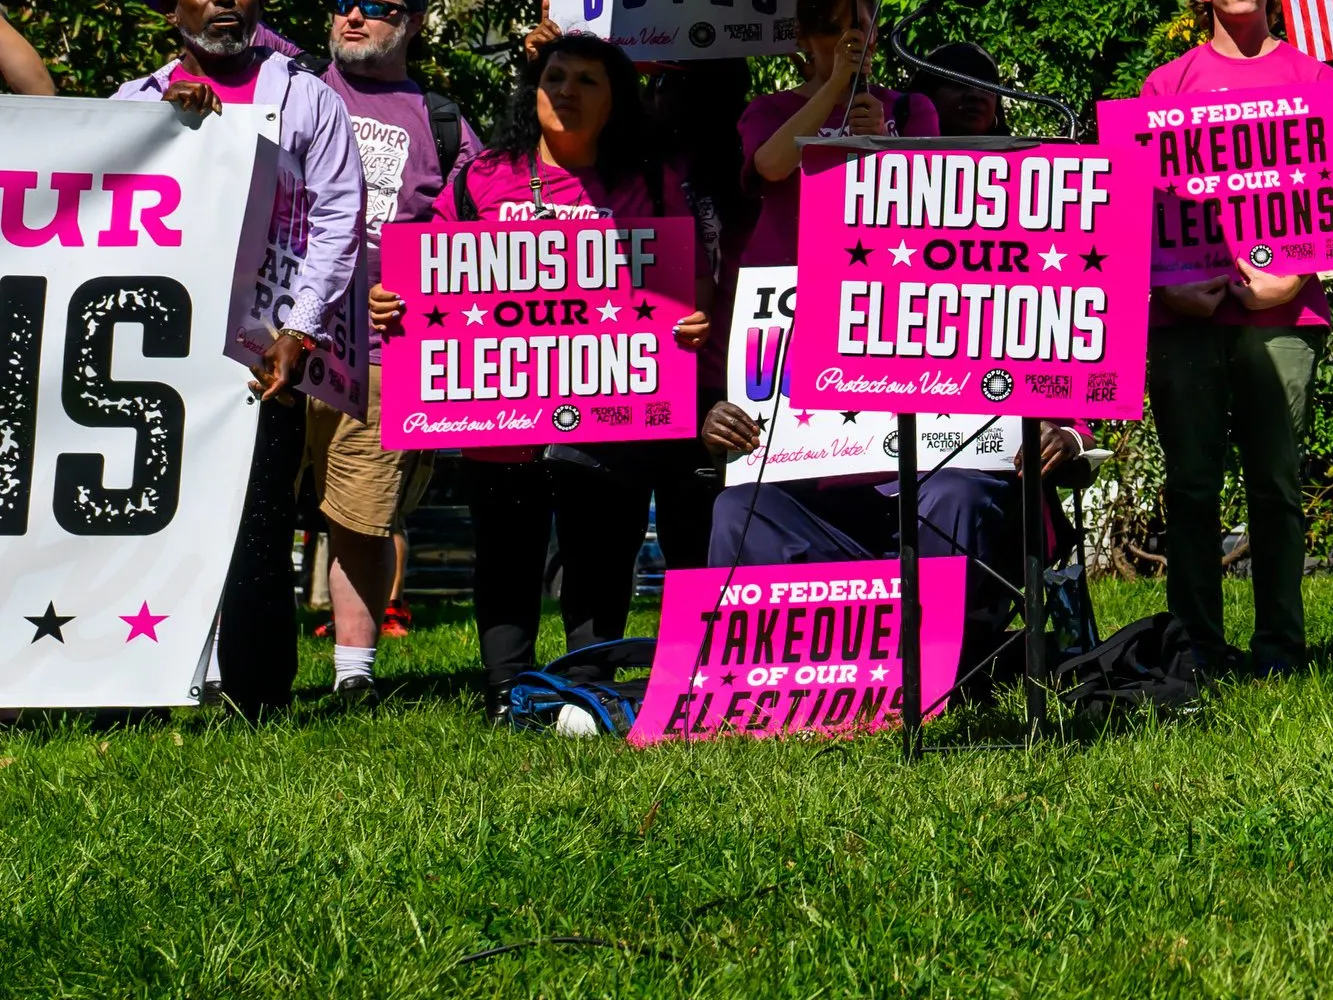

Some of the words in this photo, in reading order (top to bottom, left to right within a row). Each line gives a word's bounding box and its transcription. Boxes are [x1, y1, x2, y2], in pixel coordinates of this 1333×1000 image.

[639, 27, 680, 47] Vote!
[1148, 109, 1184, 128] NO
[1192, 97, 1309, 124] FEDERAL
[352, 122, 407, 150] POWER
[844, 152, 1011, 229] HANDS
[1018, 156, 1111, 231] OFF
[1187, 175, 1220, 195] OF
[1227, 170, 1280, 192] OUR
[420, 229, 567, 294] HANDS
[576, 228, 656, 290] OFF
[923, 239, 1029, 272] OUR
[257, 247, 299, 290] AT
[493, 299, 589, 326] OUR
[838, 280, 1106, 362] ELECTIONS
[420, 332, 658, 402] ELECTIONS
[984, 370, 1013, 383] POPULAR
[816, 367, 887, 394] Protect
[885, 380, 916, 393] our
[919, 372, 971, 396] Vote!
[1025, 374, 1069, 385] PEOPLE'S
[1032, 384, 1069, 395] ACTION
[1086, 387, 1117, 403] HERE
[403, 411, 468, 434] Protect
[467, 420, 494, 431] our
[497, 408, 543, 430] Vote!
[591, 406, 630, 415] PEOPLE'S
[596, 414, 629, 423] ACTION
[645, 414, 671, 427] HERE
[803, 447, 828, 460] our
[831, 436, 875, 457] Vote!
[922, 432, 960, 440] PEOPLE'S
[927, 440, 960, 448] ACTION
[976, 440, 1004, 455] HERE
[720, 584, 761, 606] NO
[700, 604, 903, 666] TAKEOVE
[747, 667, 788, 686] OF
[795, 664, 857, 685] OUR
